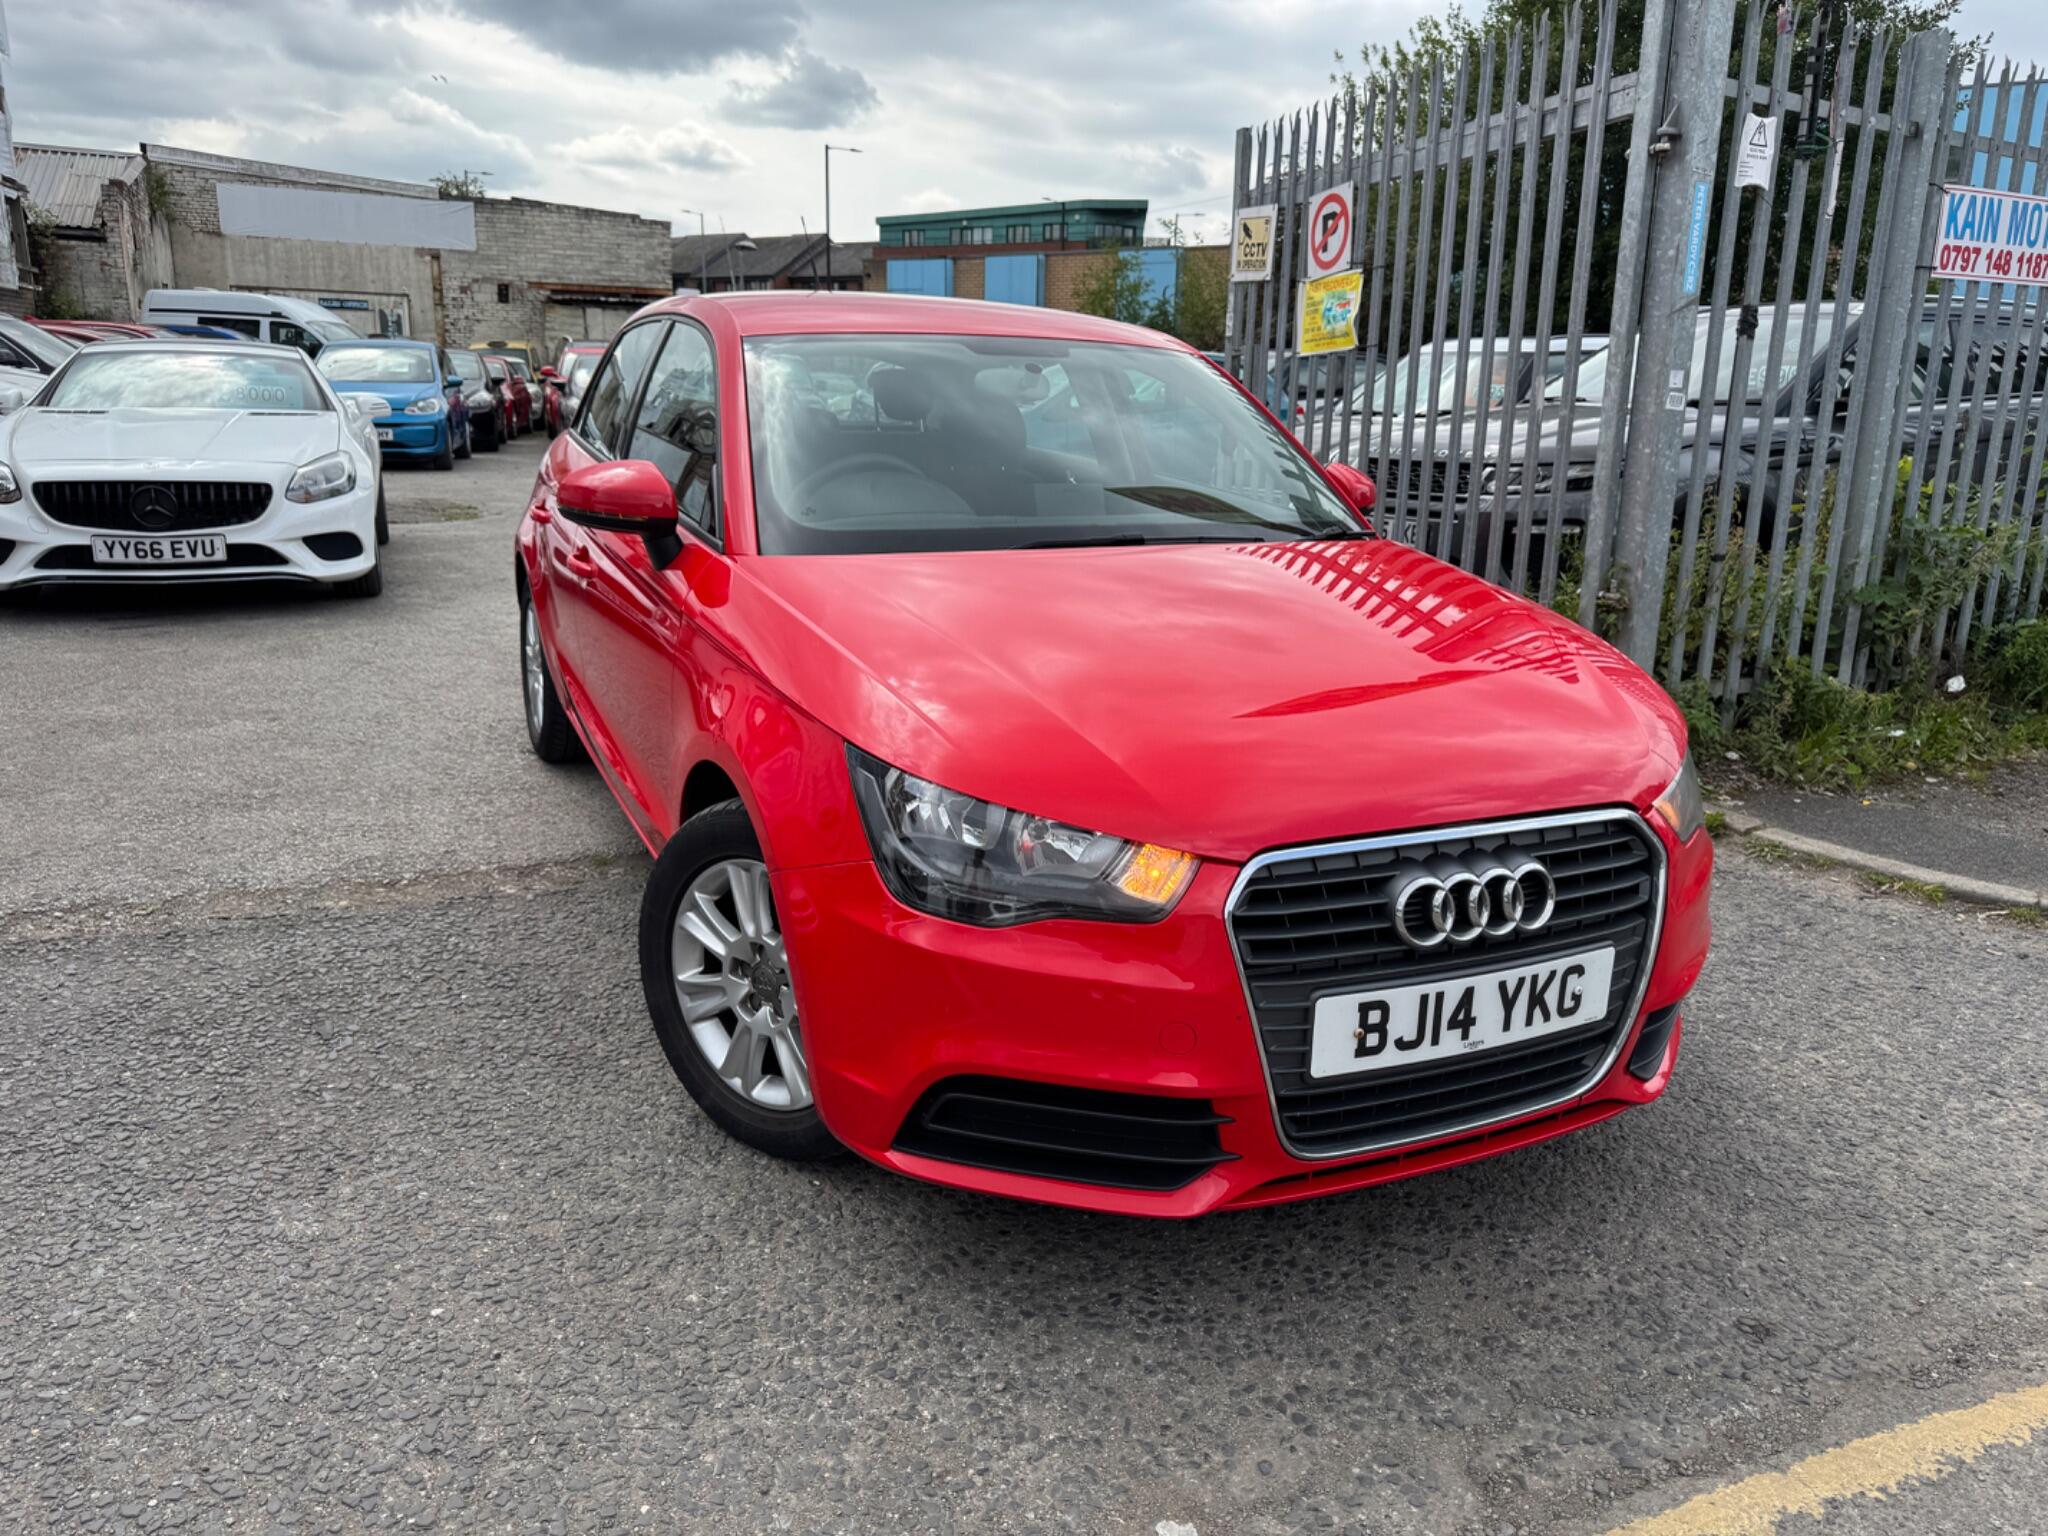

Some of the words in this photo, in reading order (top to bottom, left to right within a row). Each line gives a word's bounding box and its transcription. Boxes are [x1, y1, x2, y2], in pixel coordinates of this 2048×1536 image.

[1695, 185, 1705, 219] PETER
[1944, 193, 2002, 243] KAIN
[1243, 242, 1267, 258] CCTV
[1690, 223, 1701, 258] VARDY
[1940, 244, 1982, 272] 0797
[1985, 248, 2012, 276] 148
[2017, 251, 2048, 278] 1187
[103, 539, 164, 559] YY66
[170, 539, 216, 558] EVU
[1354, 986, 1477, 1059] BJ14
[1498, 964, 1586, 1032] YKG
